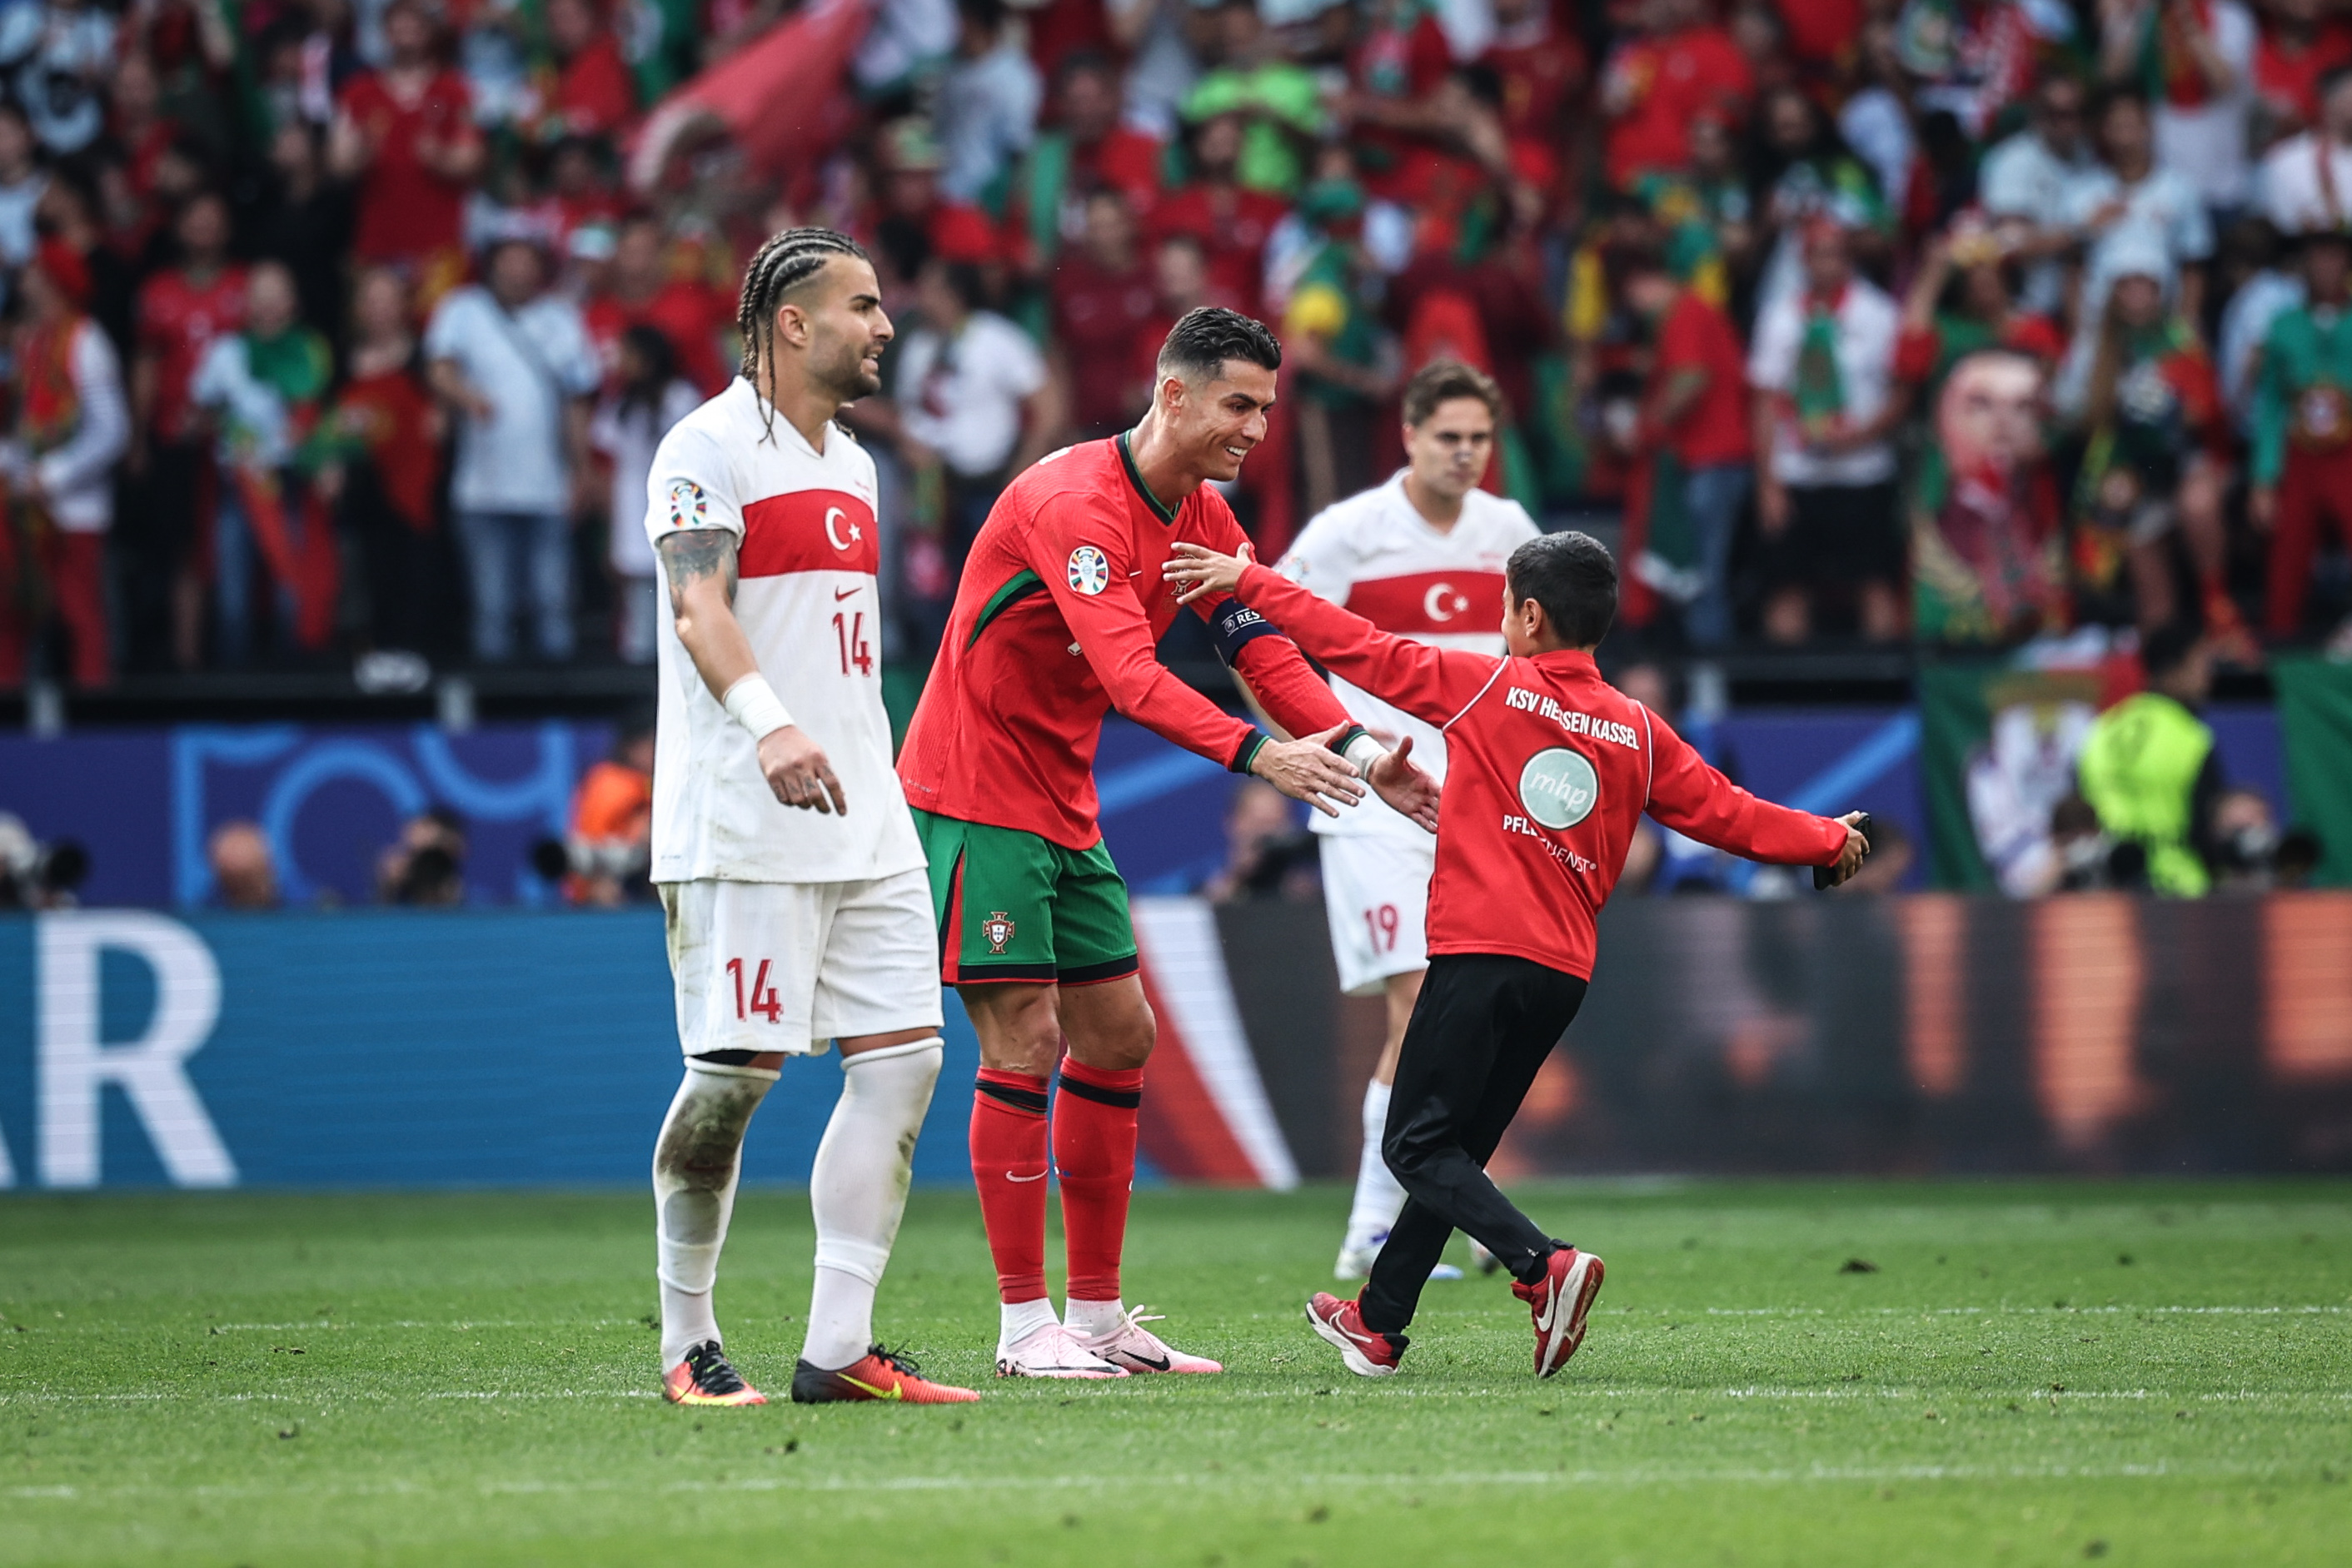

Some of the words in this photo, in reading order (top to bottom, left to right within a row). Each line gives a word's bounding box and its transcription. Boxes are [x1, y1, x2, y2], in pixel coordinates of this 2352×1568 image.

[832, 612, 874, 677] 14
[1505, 686, 1541, 713] KSV
[1591, 718, 1640, 750] KASSEL
[1530, 771, 1588, 812] mhp
[1363, 904, 1398, 957] 19
[726, 958, 785, 1024] 14
[0, 908, 241, 1190] R
